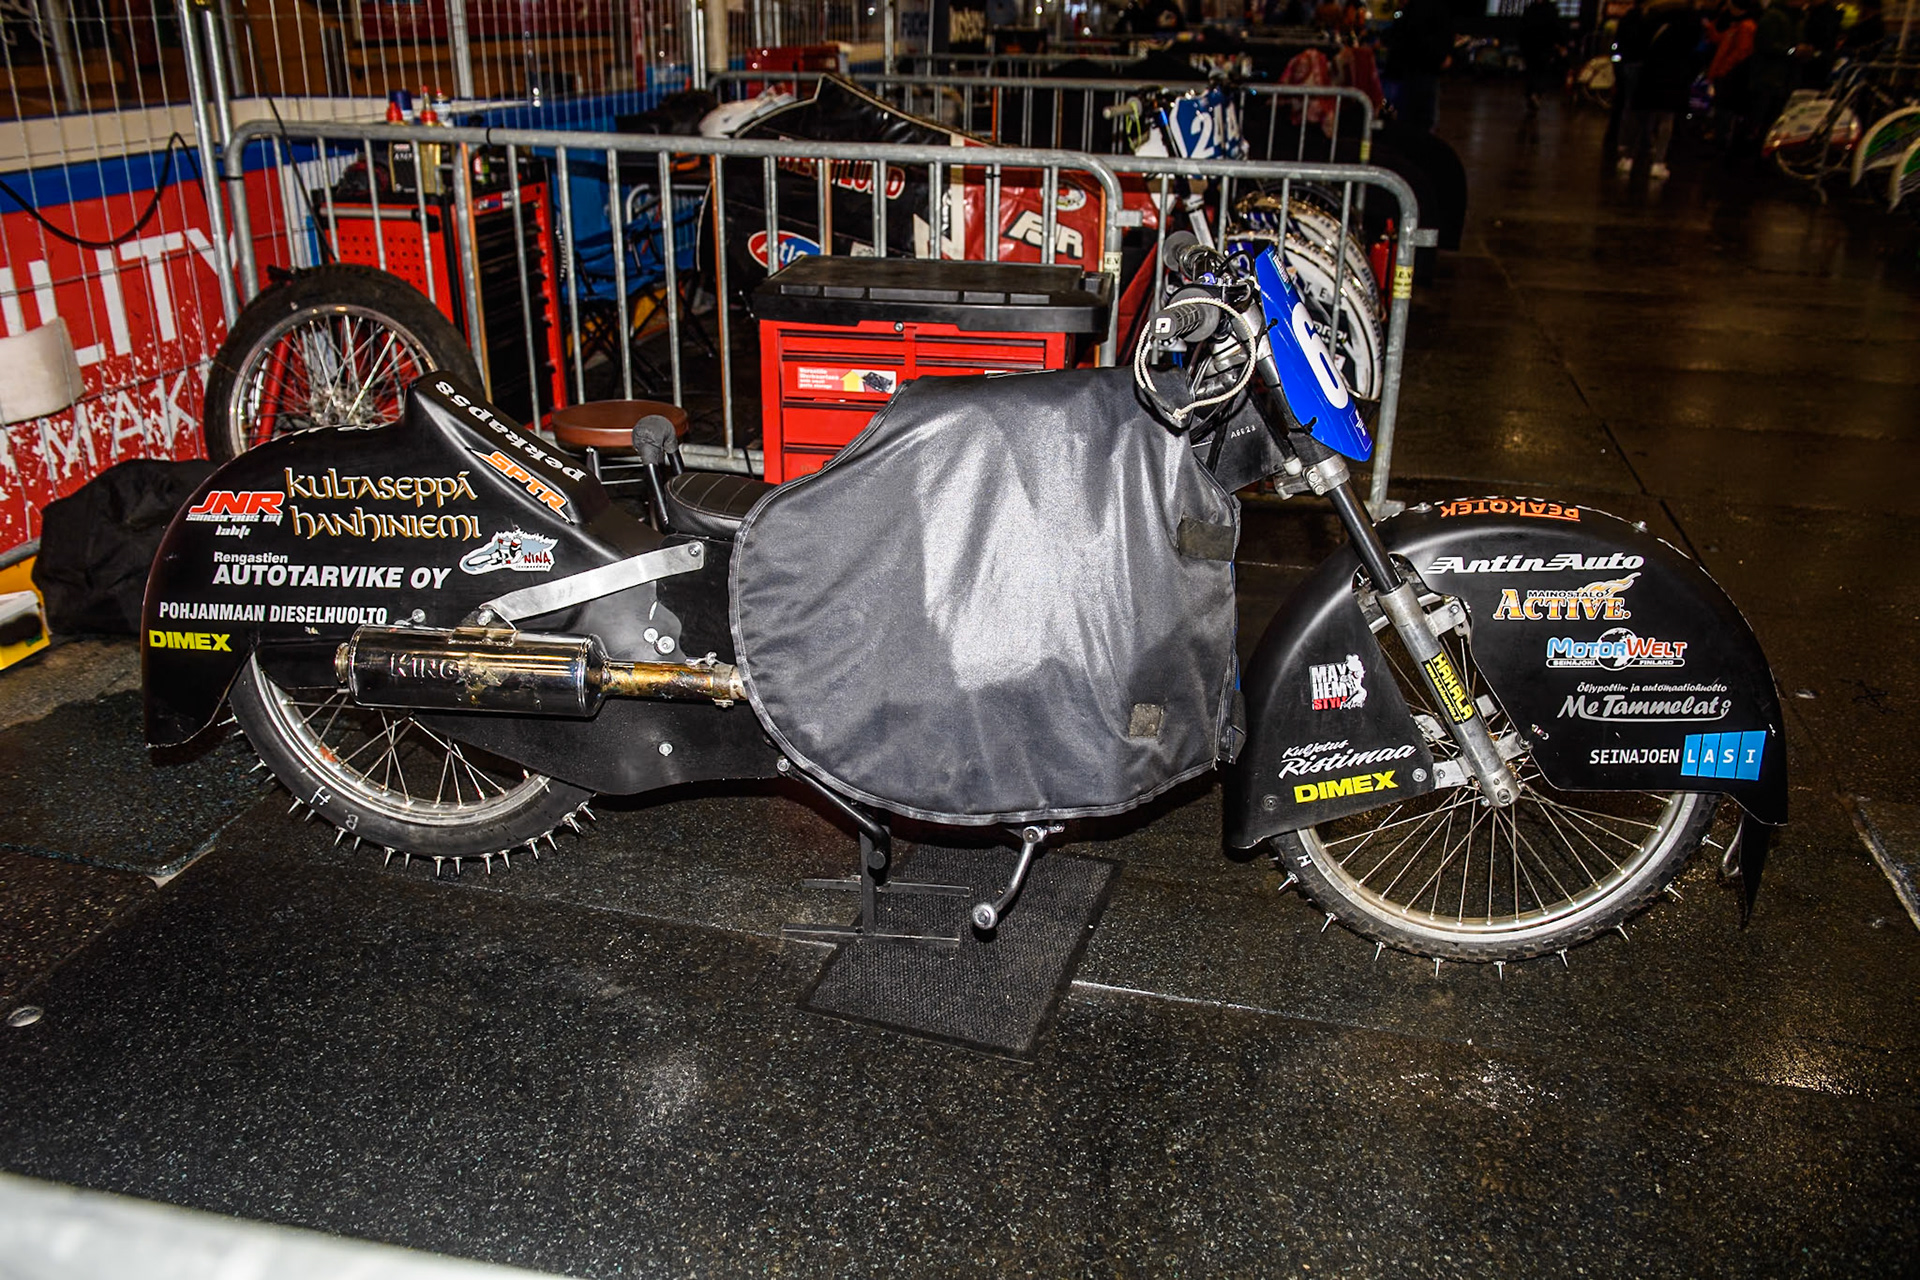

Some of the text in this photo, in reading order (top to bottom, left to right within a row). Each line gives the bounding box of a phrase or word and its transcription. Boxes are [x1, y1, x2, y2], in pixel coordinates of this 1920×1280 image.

[1292, 302, 1348, 409] 6
[435, 381, 587, 482] pekkap58
[474, 449, 571, 523] SPTR
[188, 491, 285, 515] JNR
[213, 551, 288, 565] Rengastien
[524, 552, 551, 565] NINA
[212, 564, 452, 590] AUTOTARVIKE OY
[159, 601, 388, 625] POHJANMAAN DIESELHUOLTO
[149, 629, 232, 652] DIMEX
[389, 653, 460, 680] KING
[1638, 659, 1675, 667] FINLAND
[1432, 651, 1475, 720] HAKALA
[1630, 683, 1640, 692] ja
[1278, 744, 1417, 780] Ristimaa
[1686, 748, 1757, 765] LASI
[1294, 770, 1399, 804] DIMEX
